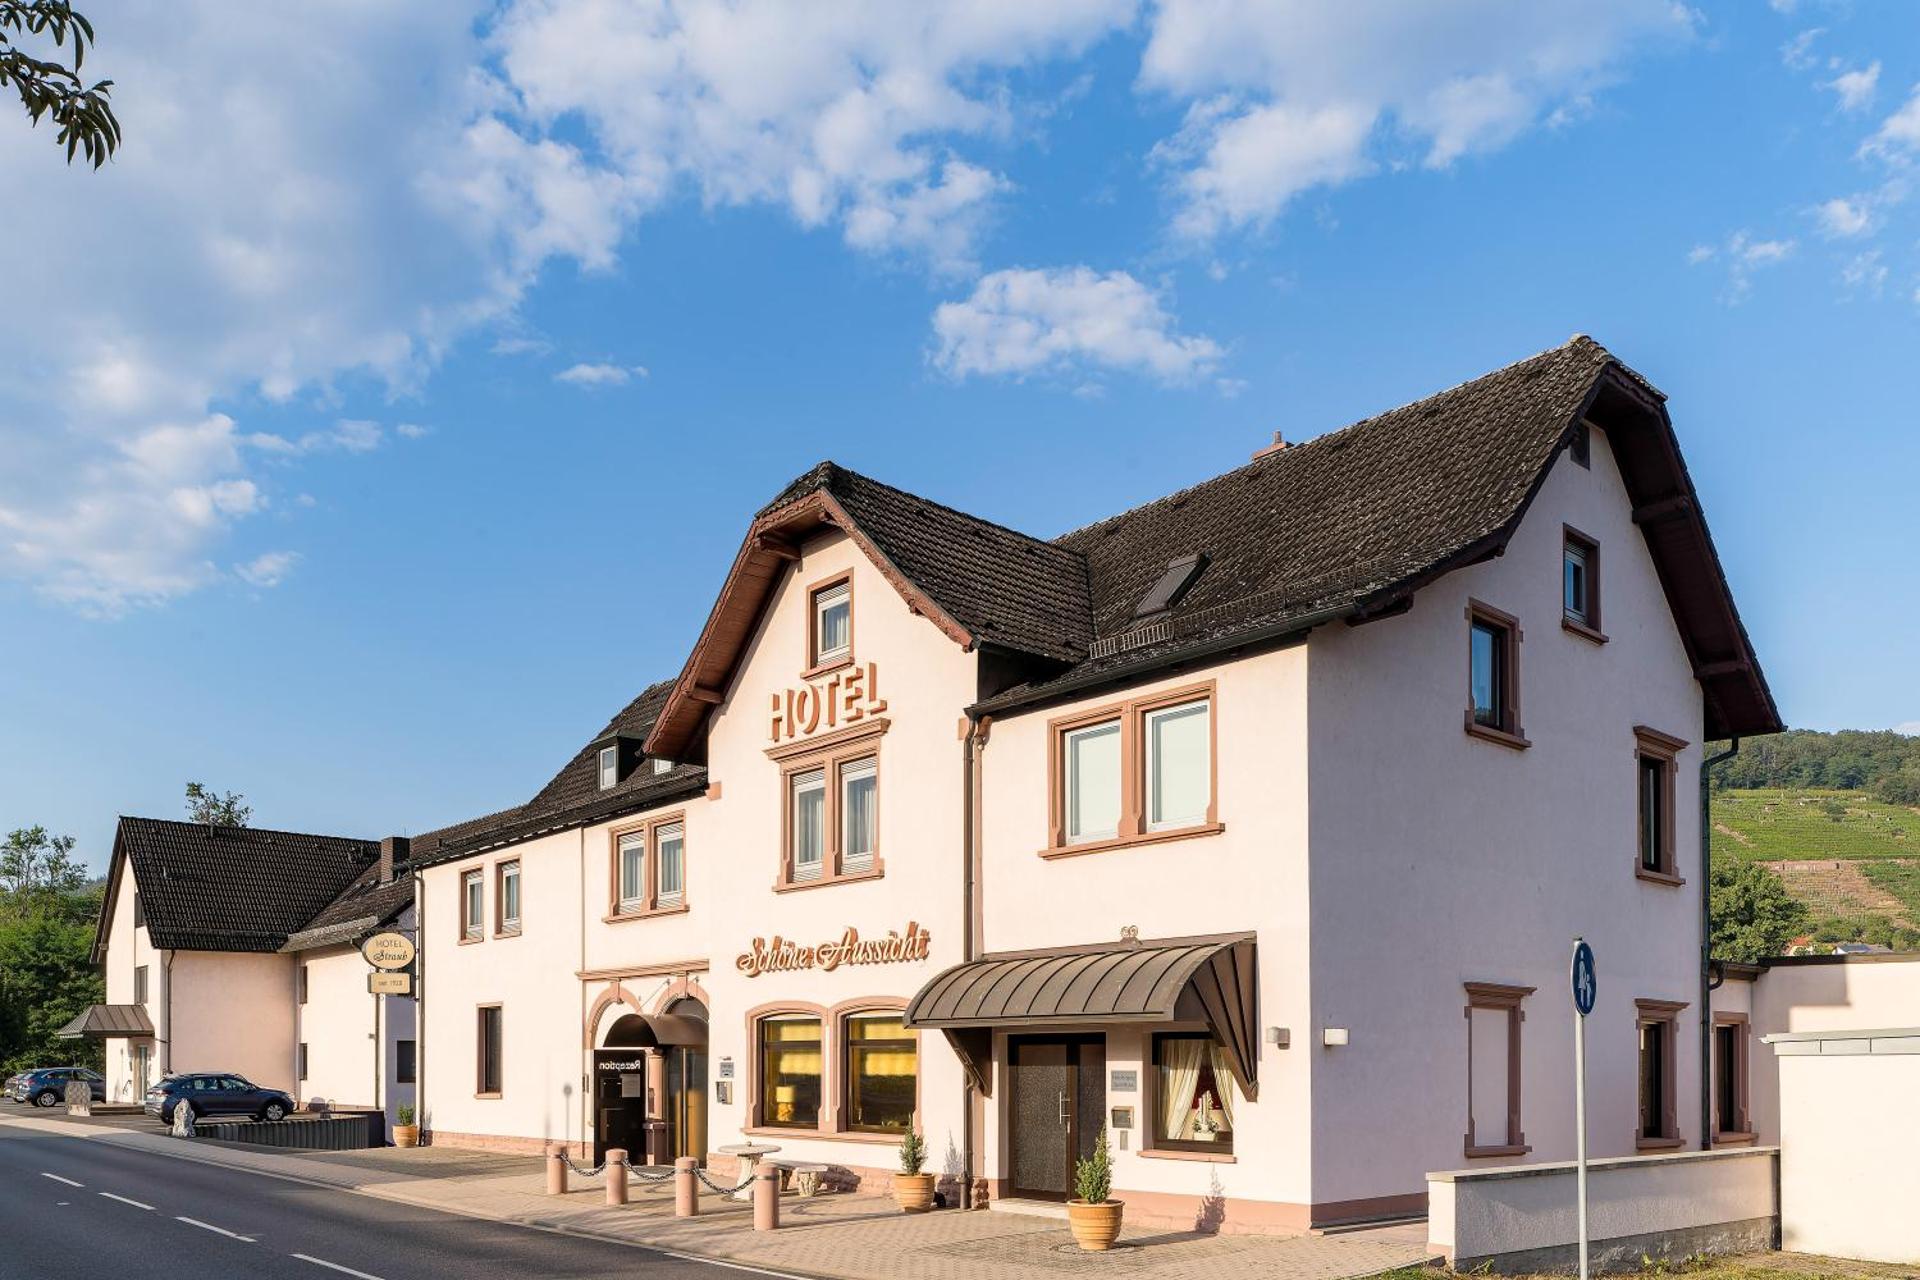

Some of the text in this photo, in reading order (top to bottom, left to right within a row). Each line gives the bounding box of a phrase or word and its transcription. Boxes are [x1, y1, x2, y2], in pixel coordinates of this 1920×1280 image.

[769, 662, 887, 742] HOTEL
[375, 939, 403, 947] HOTEL
[736, 921, 930, 978] Schöne Aussicht
